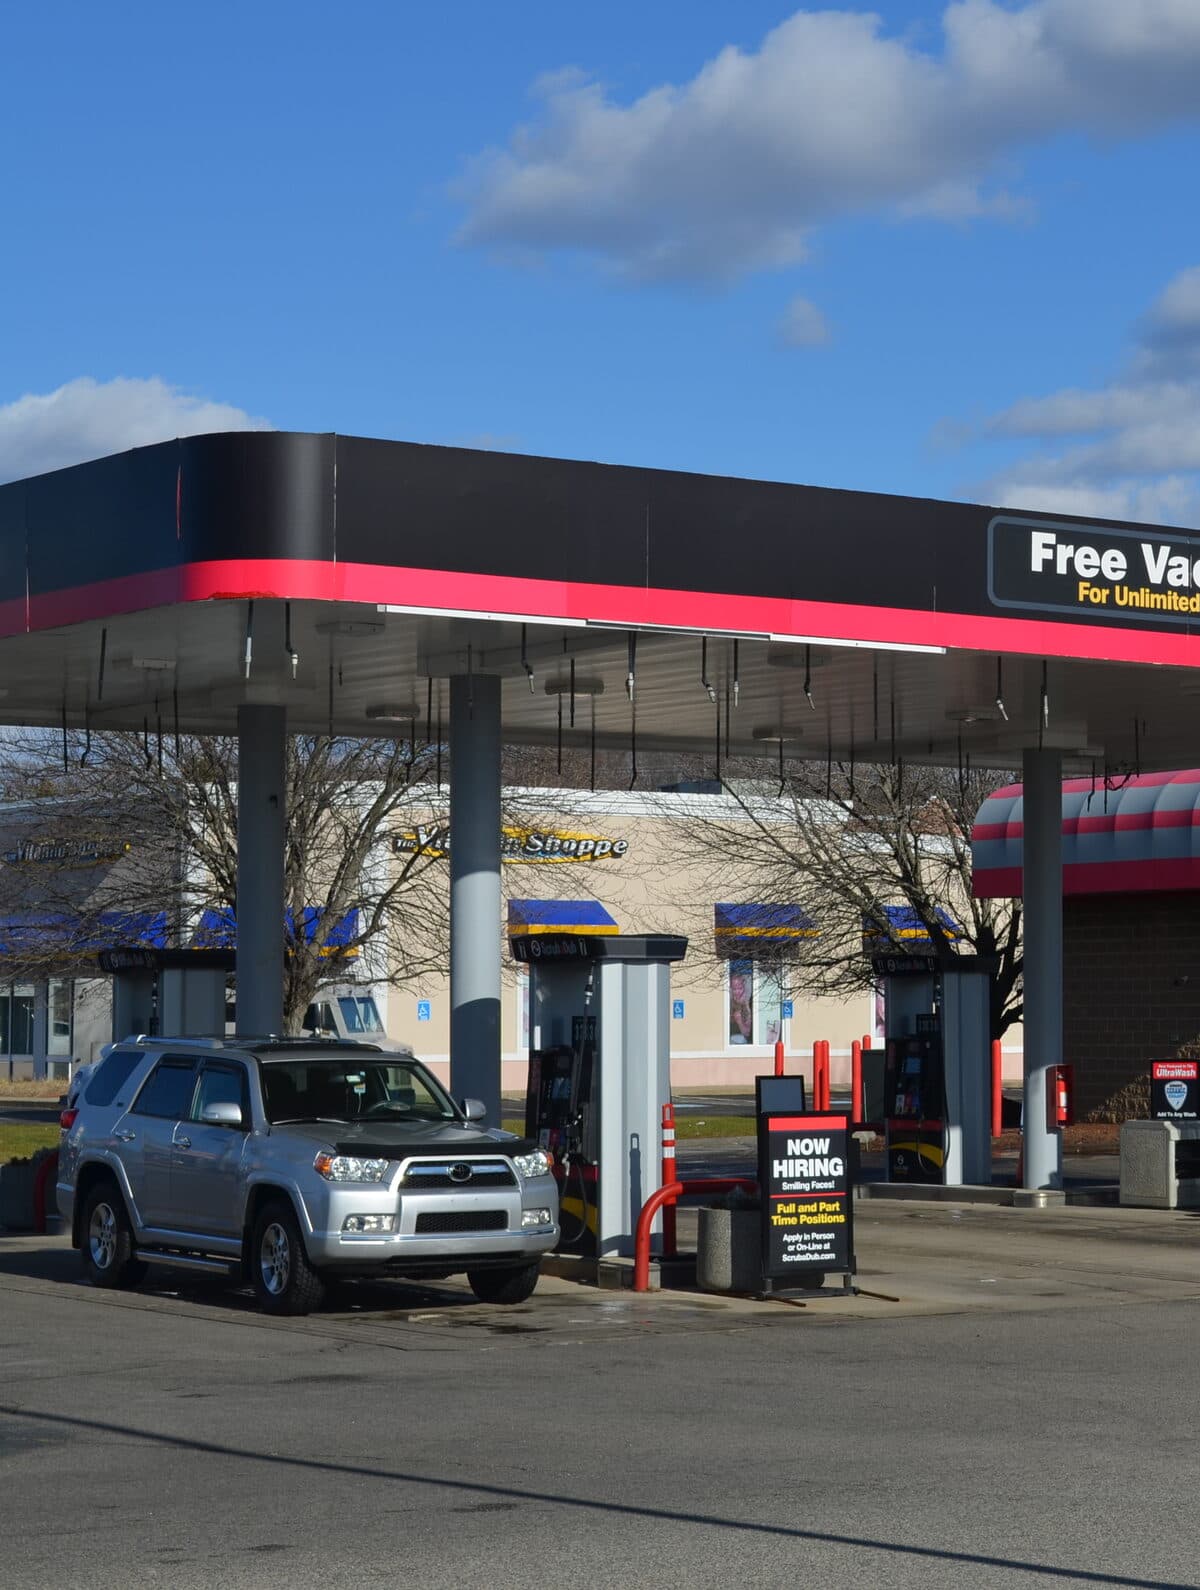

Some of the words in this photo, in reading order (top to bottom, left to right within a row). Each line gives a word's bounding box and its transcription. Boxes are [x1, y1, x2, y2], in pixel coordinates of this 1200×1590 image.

[1030, 531, 1128, 581] Free
[1078, 581, 1109, 605] For
[1114, 585, 1200, 614] Unlimited
[526, 834, 629, 857] Shoppe
[787, 1138, 831, 1156] NOW
[773, 1157, 843, 1178] HIRING
[782, 1181, 810, 1191] Smiling
[811, 1180, 835, 1189] Faces!
[777, 1203, 796, 1214] Full
[797, 1202, 817, 1213] and
[819, 1201, 840, 1212] Part
[772, 1215, 797, 1226] Time
[800, 1213, 845, 1225] Positions
[783, 1233, 802, 1242] Apply
[811, 1232, 835, 1240] Person
[823, 1242, 831, 1250] at
